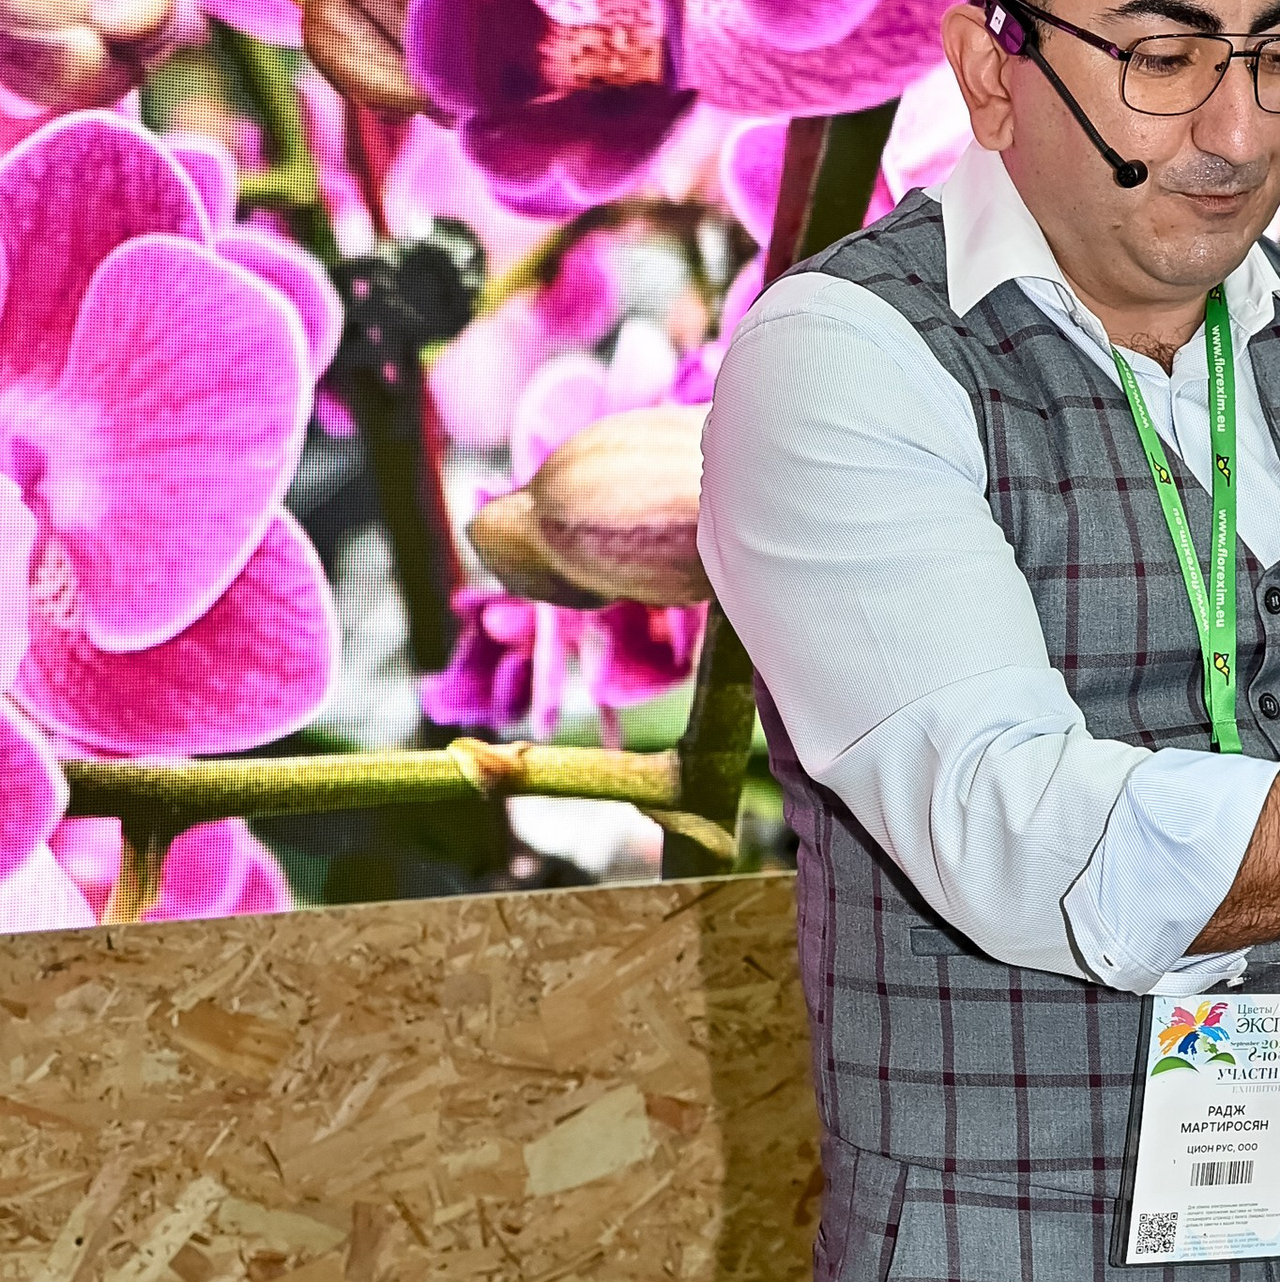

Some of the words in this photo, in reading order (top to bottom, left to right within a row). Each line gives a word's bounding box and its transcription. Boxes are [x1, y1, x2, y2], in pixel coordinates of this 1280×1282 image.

[1212, 325, 1227, 432] www.florexim.eu
[1172, 507, 1209, 633] www.florexim.eu
[1216, 509, 1227, 629] www.florexim.eu
[1248, 1046, 1277, 1061] 8-10
[1208, 1104, 1246, 1118] РАДЖ
[1180, 1120, 1269, 1133] МАРТИРОСЯН
[1187, 1145, 1214, 1154] ЦИОН
[1216, 1144, 1235, 1153] РУС,
